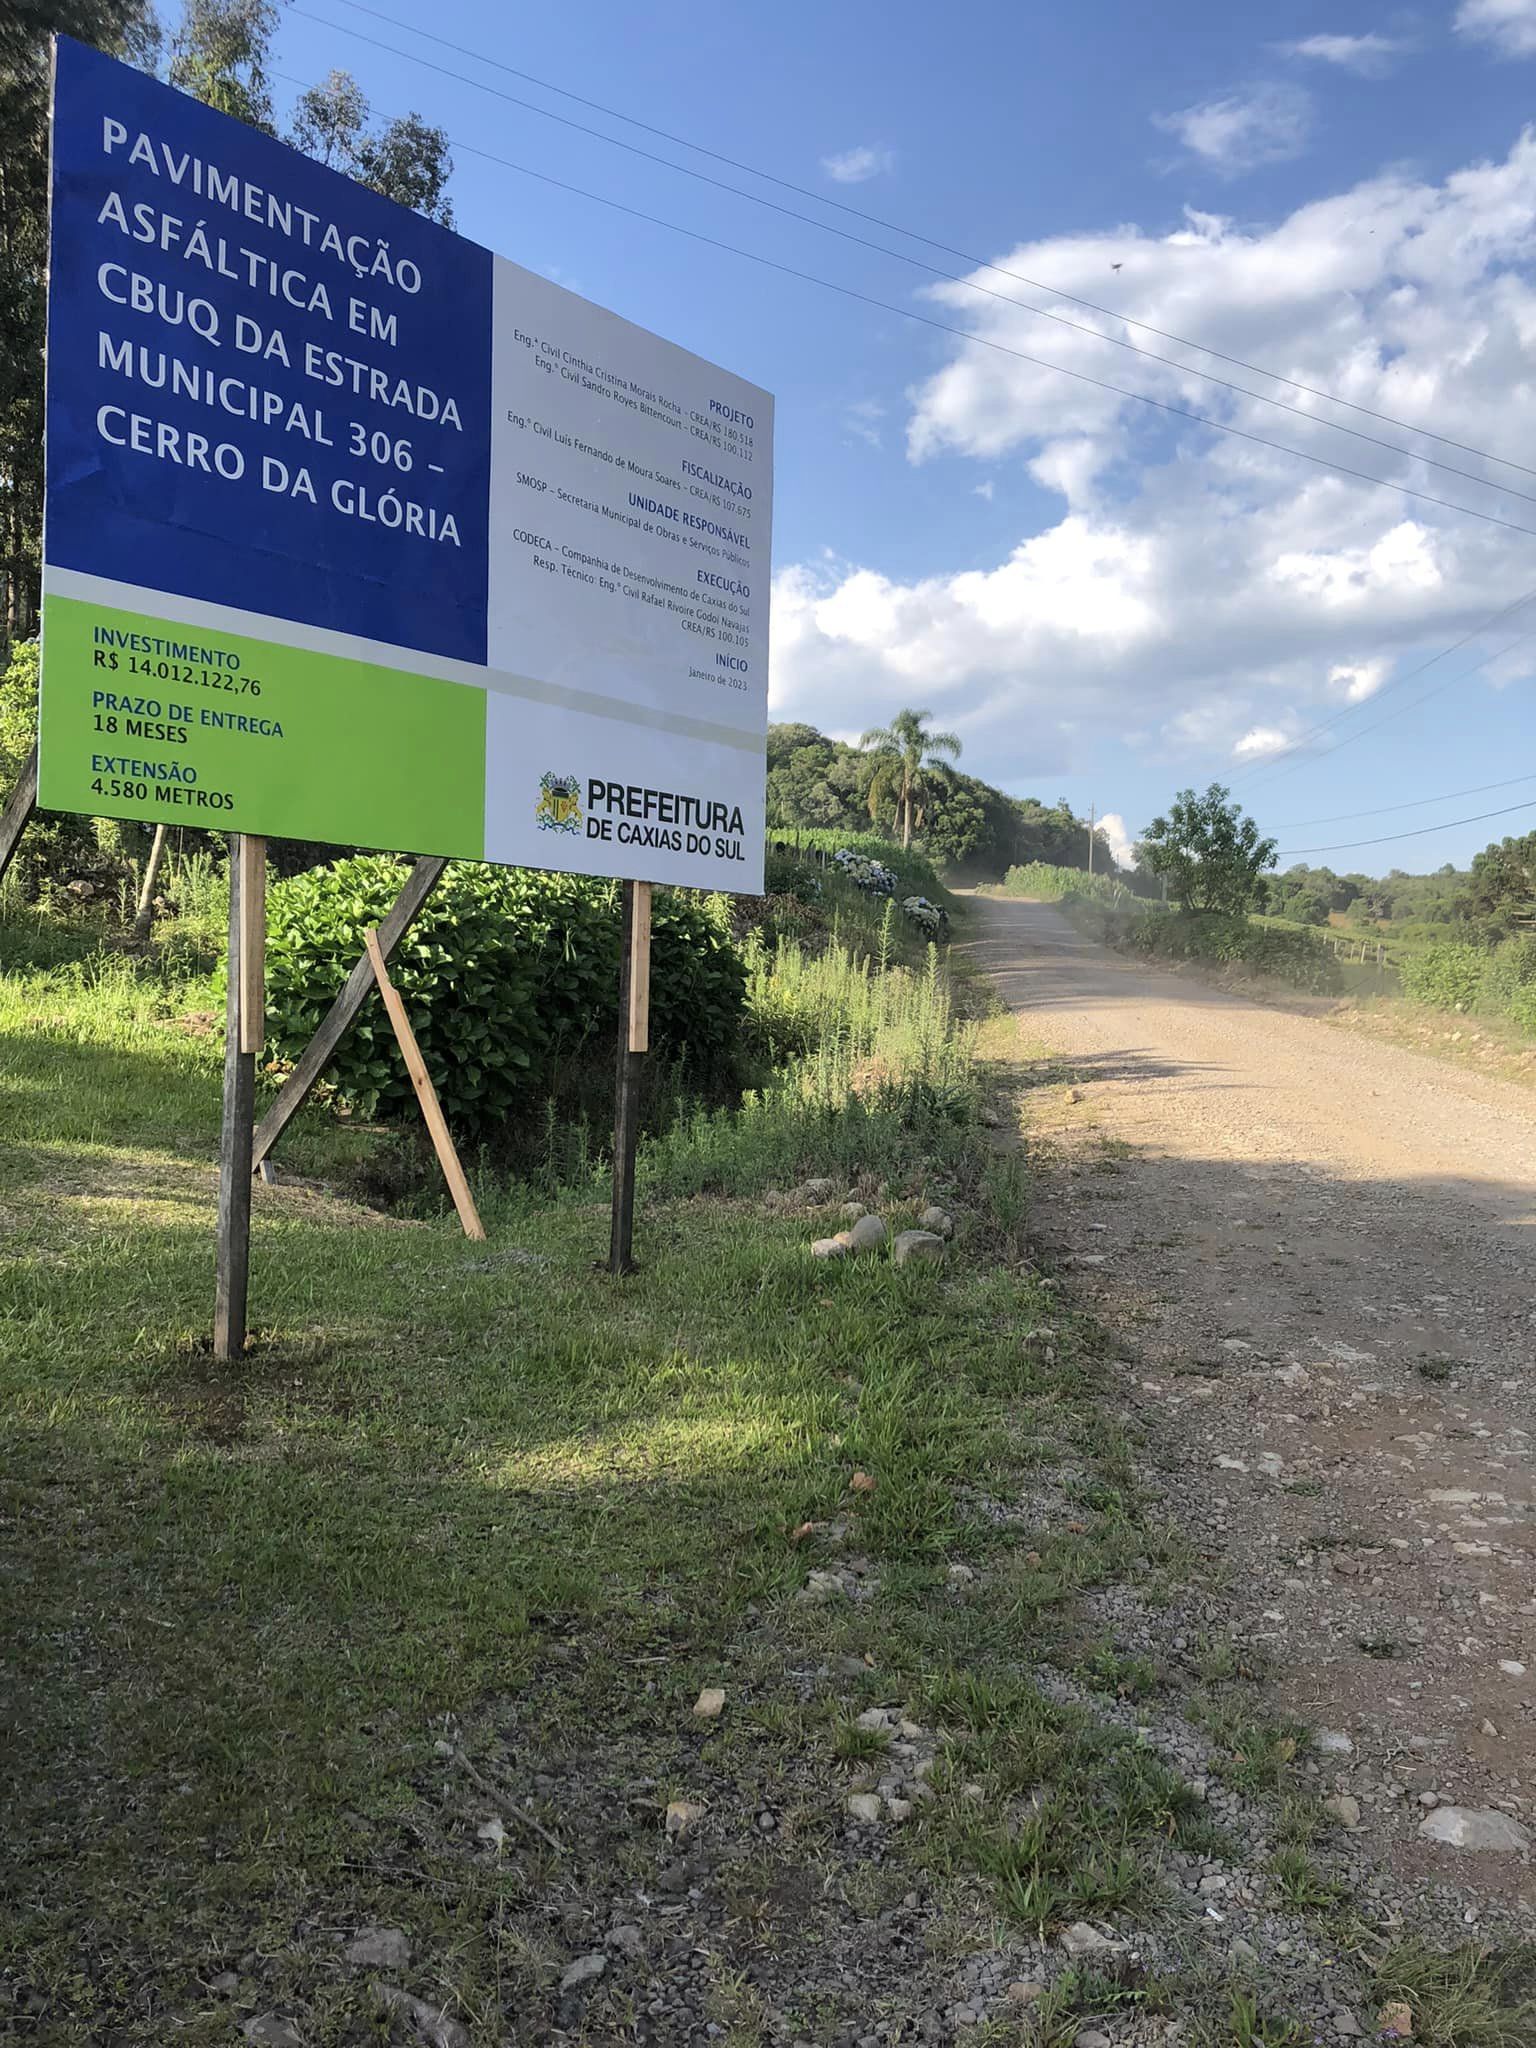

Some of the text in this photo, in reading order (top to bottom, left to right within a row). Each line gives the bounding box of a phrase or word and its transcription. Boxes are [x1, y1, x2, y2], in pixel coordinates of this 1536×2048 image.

[103, 116, 422, 294] PAVIMENTAÇÃO
[97, 191, 398, 346] ASFÁLTICA EM
[98, 262, 463, 431] CBUQ DA ESTRADA
[99, 331, 334, 446] MUNICIPAL
[349, 422, 413, 472] 306
[541, 342, 560, 359] Civil
[563, 352, 593, 374] Cinthia
[595, 367, 627, 390] Cristina
[630, 382, 656, 402] Morais
[658, 395, 681, 415] Rocha
[690, 411, 721, 432] CREA/RS
[561, 367, 579, 384] Civil
[582, 376, 611, 398] Sandro
[613, 391, 638, 409] Royes
[640, 402, 681, 430] Bittencourt
[690, 425, 721, 447] CREA/RS
[724, 441, 753, 461] 100.112
[709, 399, 754, 429] PROJETO
[97, 405, 461, 546] CERRO DA GLÓRIA
[533, 422, 551, 439] Civil
[554, 430, 572, 447] Luis
[574, 439, 613, 463] Fernando
[615, 456, 625, 469] de
[628, 460, 653, 479] Moura
[655, 472, 681, 490] Soares
[690, 485, 720, 506] CREA/RS
[682, 460, 752, 500] FISCALIZAÇÃO
[516, 471, 547, 492] SMOSP
[557, 488, 599, 513] Secretaria
[601, 505, 640, 528] Municipal
[643, 521, 654, 533] de
[655, 525, 680, 542] Obras
[690, 537, 720, 557] Serviços
[628, 492, 750, 549] UNIDADE RESPONSÁVEL
[513, 528, 552, 551] CODECA
[561, 545, 609, 571] Companhia
[611, 563, 621, 575] de
[623, 567, 688, 597] Desenvolvimento
[690, 589, 700, 600] de
[702, 593, 726, 609] Caxias
[728, 602, 738, 613] do
[739, 605, 750, 616] Sul
[533, 554, 558, 572] Resp.
[623, 584, 639, 599] Civil
[641, 591, 665, 608] Rafael
[667, 600, 694, 616] Rivoire
[696, 608, 719, 624] Godoi
[697, 570, 750, 598] EXECUÇÃO
[94, 626, 240, 670] INVESTIMENTO
[681, 619, 715, 638] CREA/RS
[93, 649, 261, 696] R$ 14.012.122,76
[688, 666, 747, 691] Janeiro de 2023
[715, 652, 748, 672] INÍCIO
[93, 691, 284, 738] PRAZO DE ENTREGA
[94, 714, 188, 743] 18 MESES
[91, 778, 234, 810] 4.580 METROS
[92, 754, 197, 784] EXTENSÃO
[587, 778, 744, 836] PREFEITURA
[587, 817, 745, 861] DE CAXIAS DO SUL
